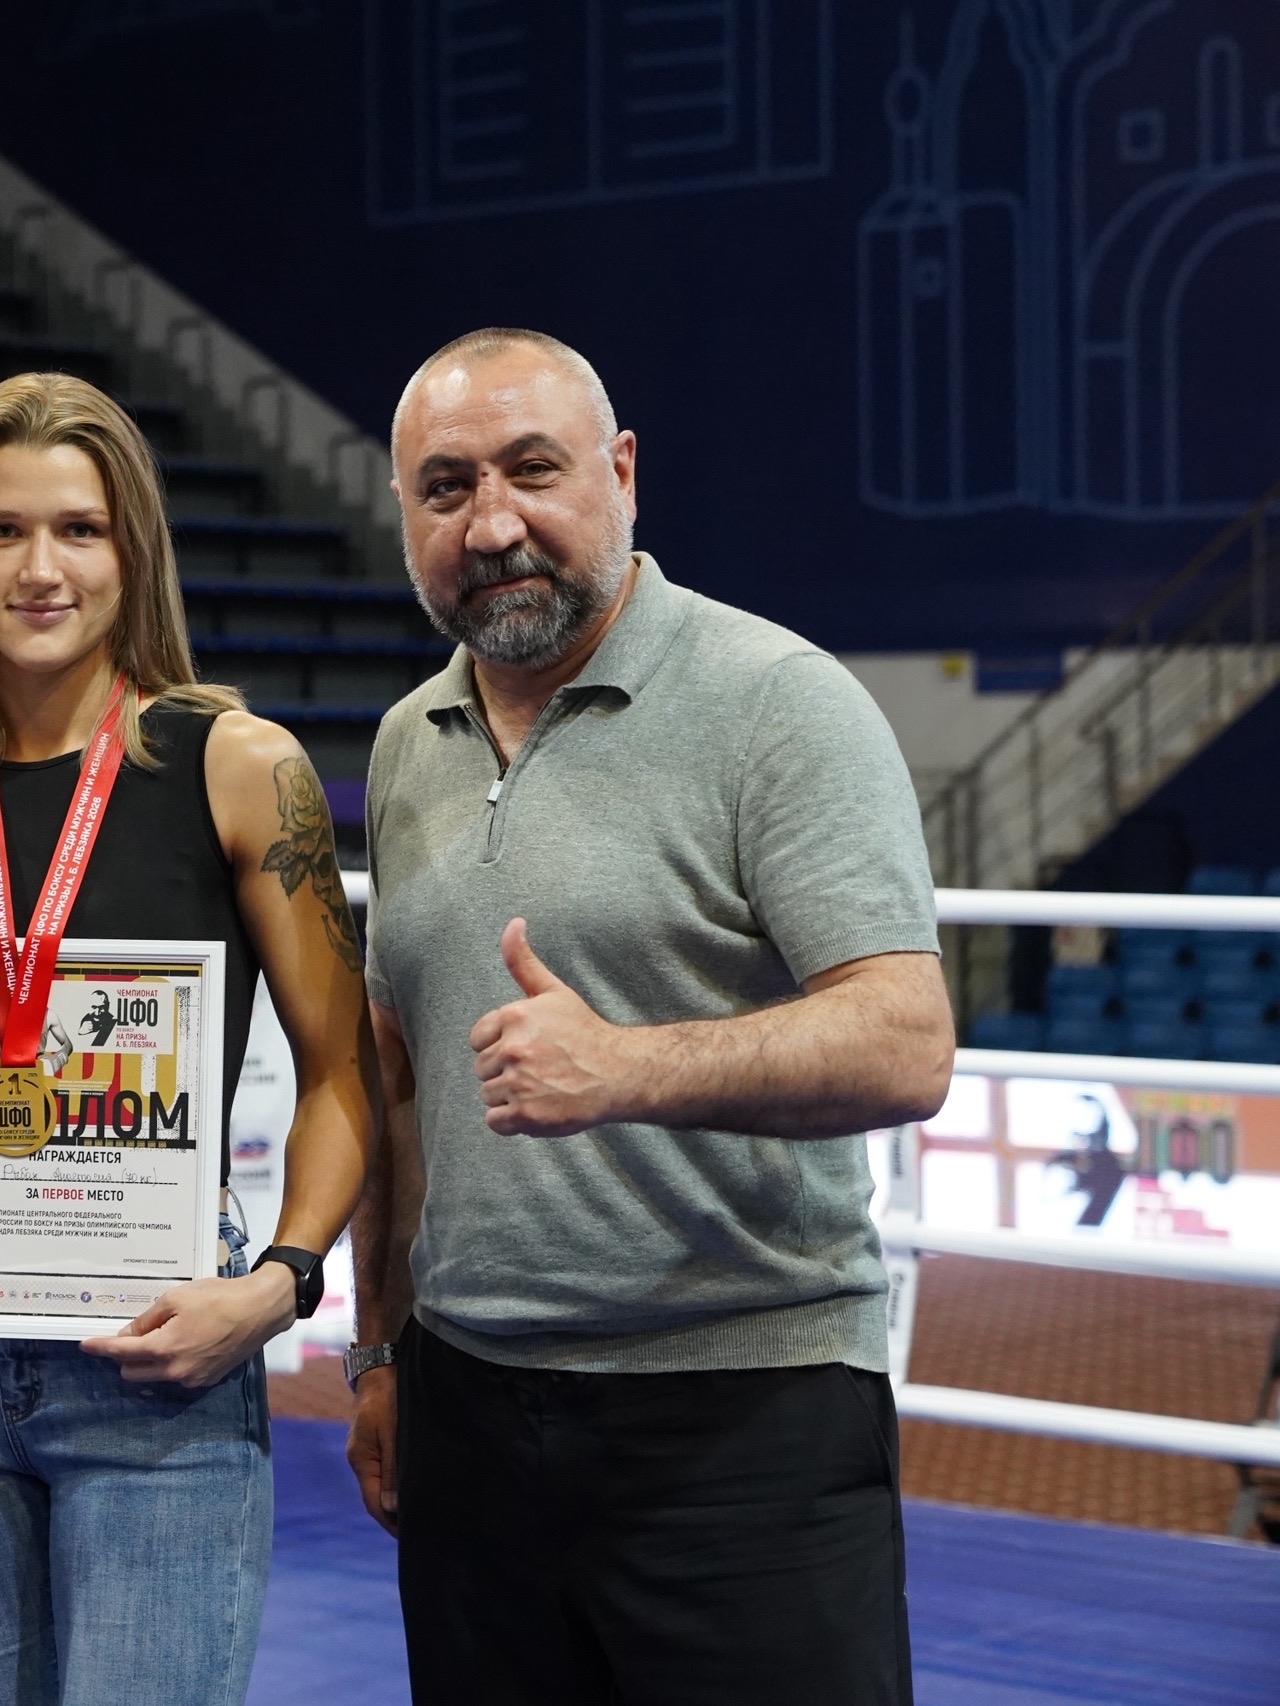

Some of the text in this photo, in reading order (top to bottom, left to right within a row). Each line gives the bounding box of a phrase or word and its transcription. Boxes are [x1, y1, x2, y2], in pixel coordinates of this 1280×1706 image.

[87, 796, 102, 820] 2026
[72, 822, 94, 865] ЛЕБЗЯКА
[16, 732, 110, 1004] ЧЕМПИОНАТ ЦФО ПО БОКСУ СРЕДИ МУЖЧИН И ЖЕНЩИН
[68, 866, 80, 875] Б.
[52, 886, 72, 920] ПРИЗЫ
[48, 921, 60, 935] НА
[0, 940, 10, 948] И
[2, 950, 16, 997] ЖЕНЩ
[117, 998, 158, 1027] ЦФО
[0, 1106, 31, 1128] ЦФО
[28, 1150, 121, 1164] НАГРАЖДАЕТСЯ
[26, 1188, 124, 1201] ЗА ПЕРВОЕ МЕСТО
[86, 1221, 137, 1229] ОЛИМПИЙСКОГО
